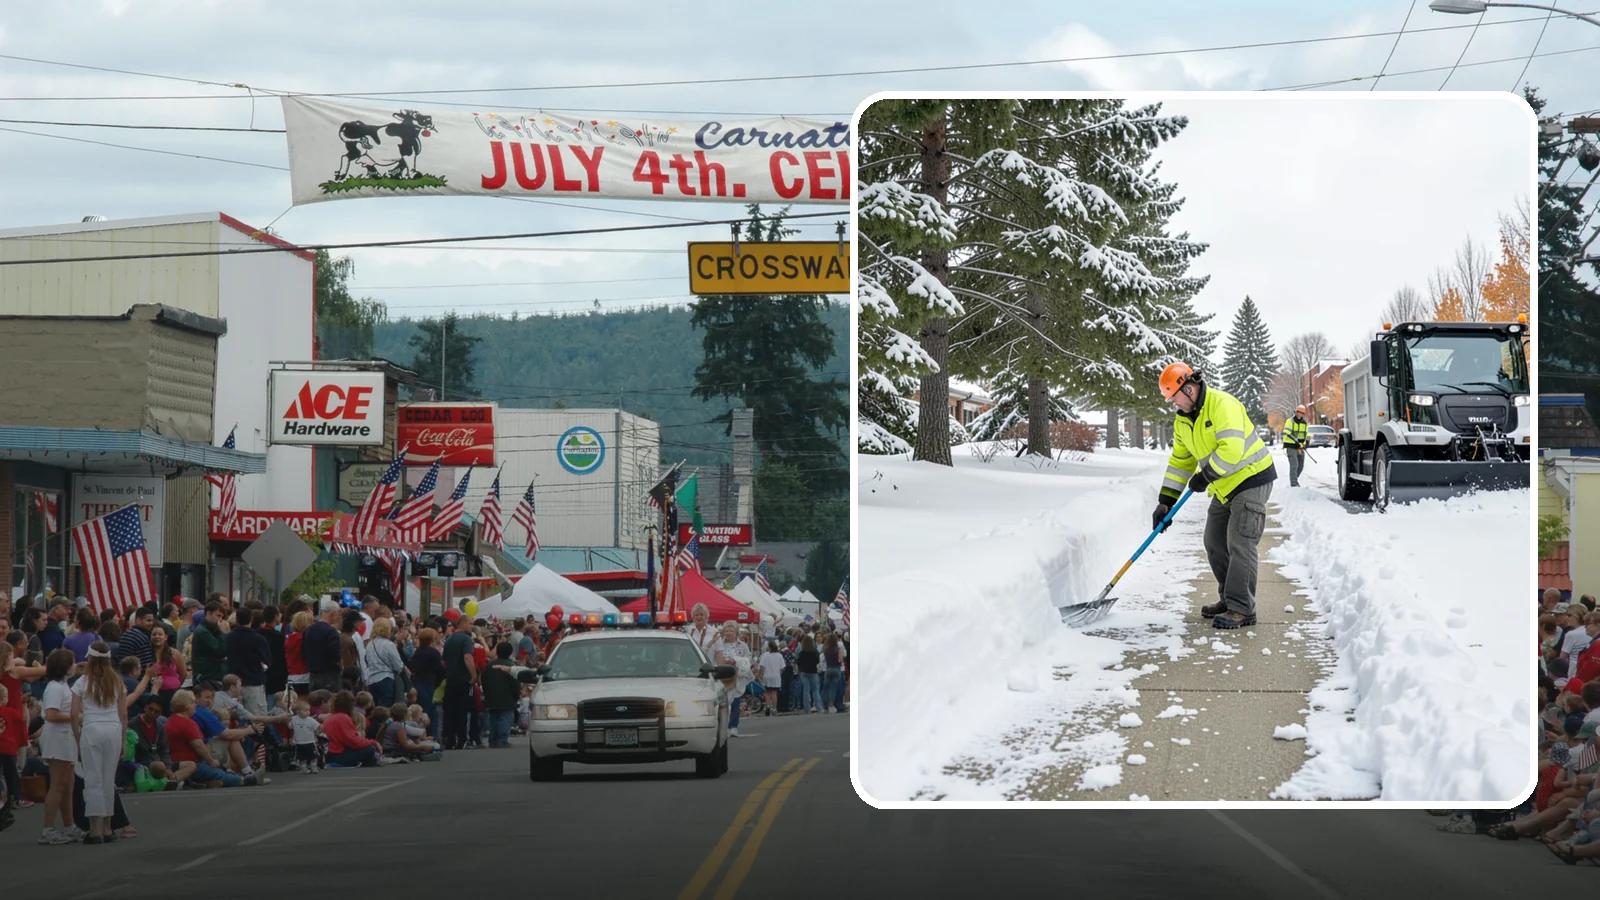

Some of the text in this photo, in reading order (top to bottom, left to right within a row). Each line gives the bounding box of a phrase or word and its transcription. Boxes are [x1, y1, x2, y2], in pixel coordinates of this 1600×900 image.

[695, 121, 850, 150] Carnat
[481, 141, 605, 192] JULY
[632, 150, 747, 198] 4th.
[697, 254, 850, 280] CROSSWA
[283, 380, 373, 420] ACE
[405, 409, 452, 421] CEDAR
[283, 421, 371, 436] Hardware
[416, 428, 477, 446] Coca-Cola
[96, 485, 124, 494] Vincent
[126, 485, 136, 494] de
[138, 486, 155, 495] Paul
[212, 516, 330, 535] HARDARE
[688, 526, 741, 535] CRNATION
[699, 535, 730, 543] GLASS
